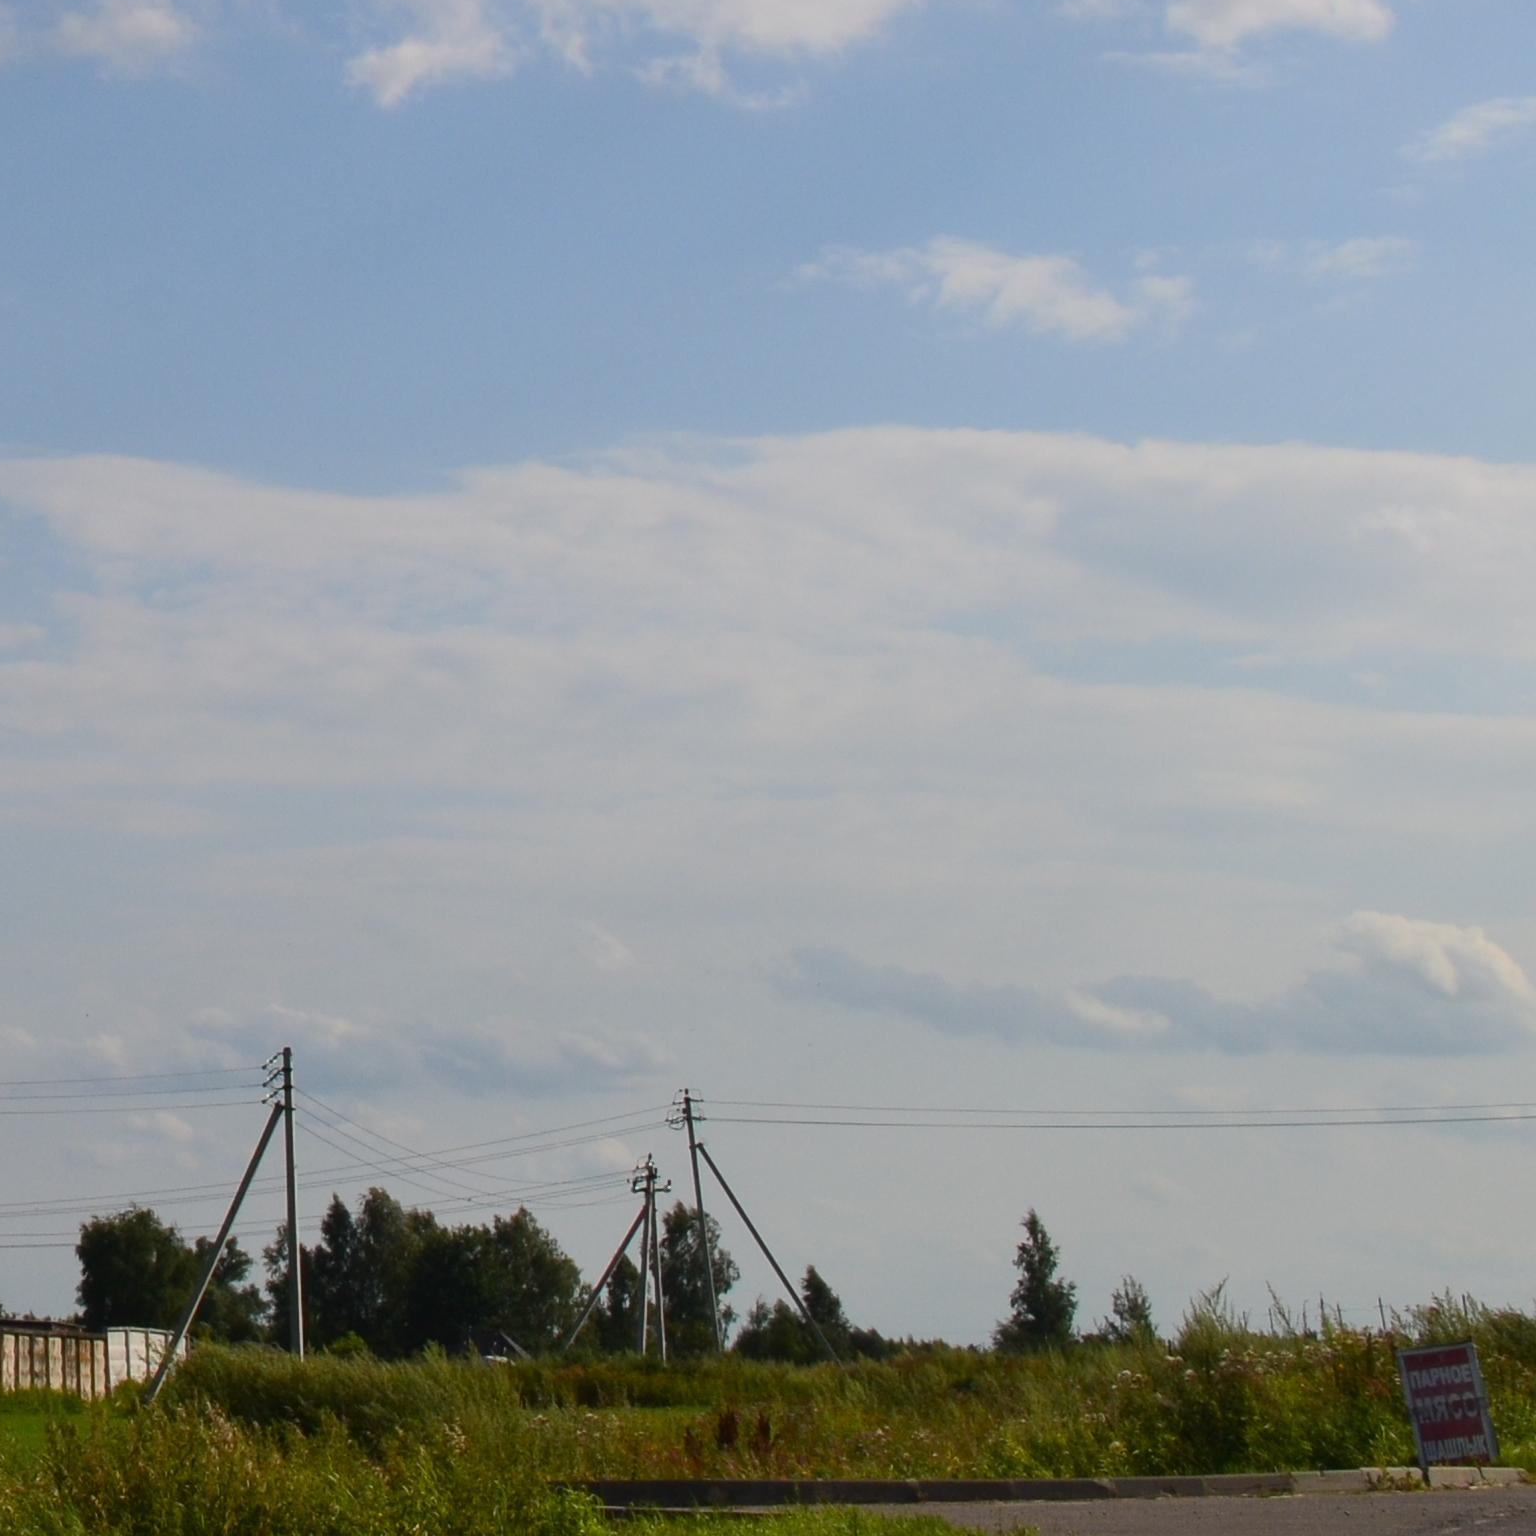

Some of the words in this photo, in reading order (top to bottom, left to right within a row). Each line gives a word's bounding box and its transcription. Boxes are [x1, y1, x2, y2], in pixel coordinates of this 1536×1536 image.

[1409, 1364, 1472, 1389] ПАРНОЕ
[1416, 1391, 1478, 1424] МЯСО
[1424, 1434, 1488, 1459] ШАШЛЫК
